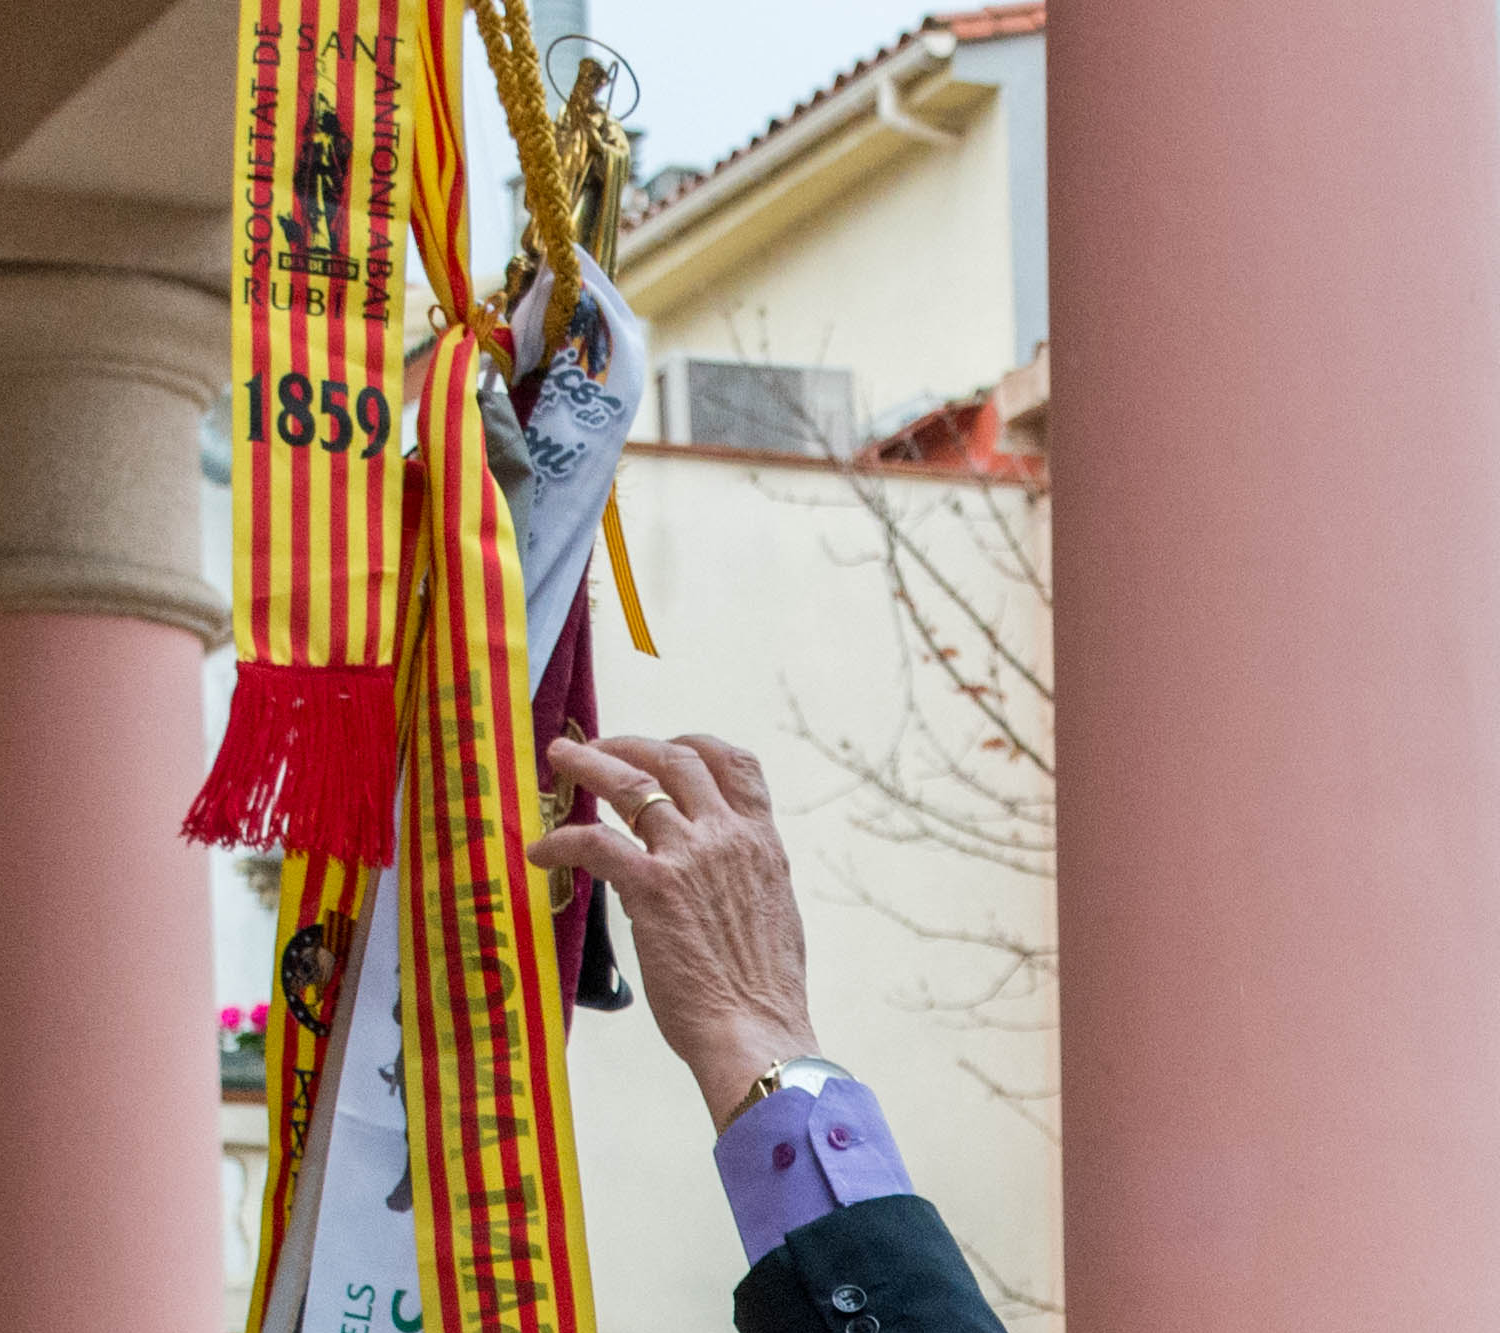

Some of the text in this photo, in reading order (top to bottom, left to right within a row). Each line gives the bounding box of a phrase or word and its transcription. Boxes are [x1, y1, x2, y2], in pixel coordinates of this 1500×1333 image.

[244, 22, 404, 330] SOCIETAT DE SANT ANTONI ABAT
[244, 369, 391, 460] 1859
